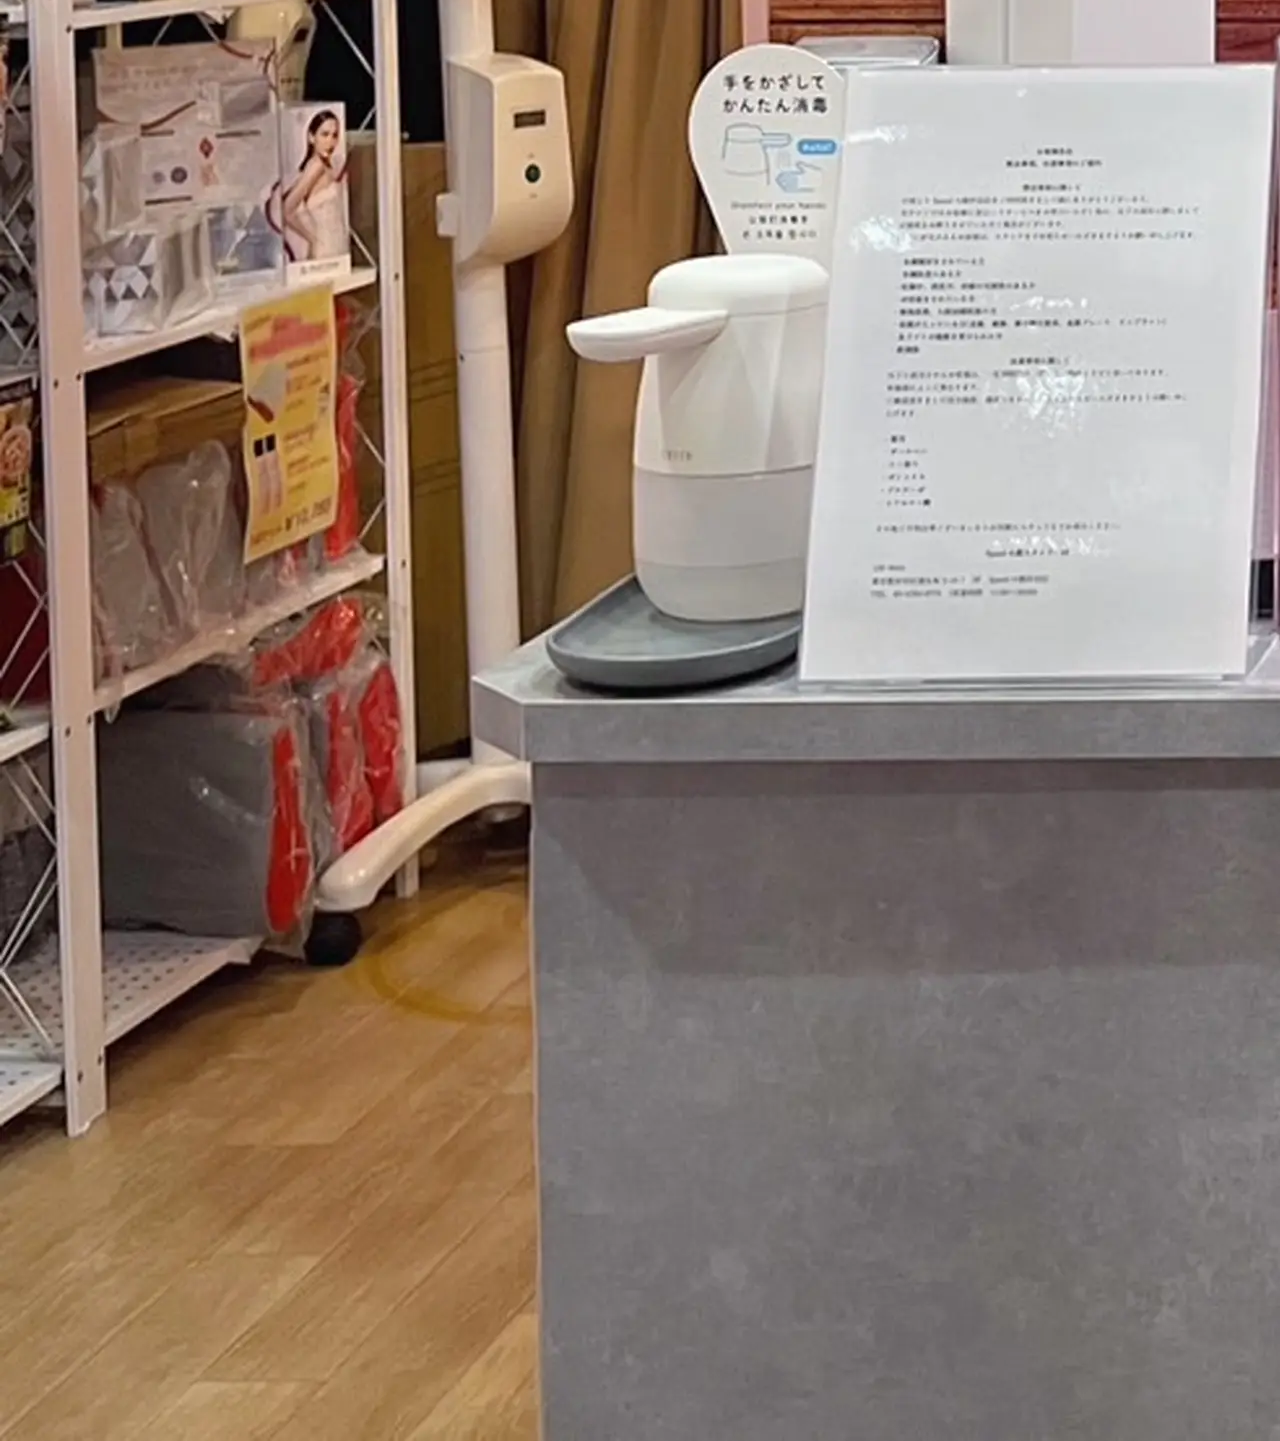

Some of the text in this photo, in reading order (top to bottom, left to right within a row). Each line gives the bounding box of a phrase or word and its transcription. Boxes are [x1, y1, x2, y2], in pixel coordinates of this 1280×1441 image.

[723, 74, 825, 91] 手をかざして
[723, 97, 829, 114] かんたん消毒
